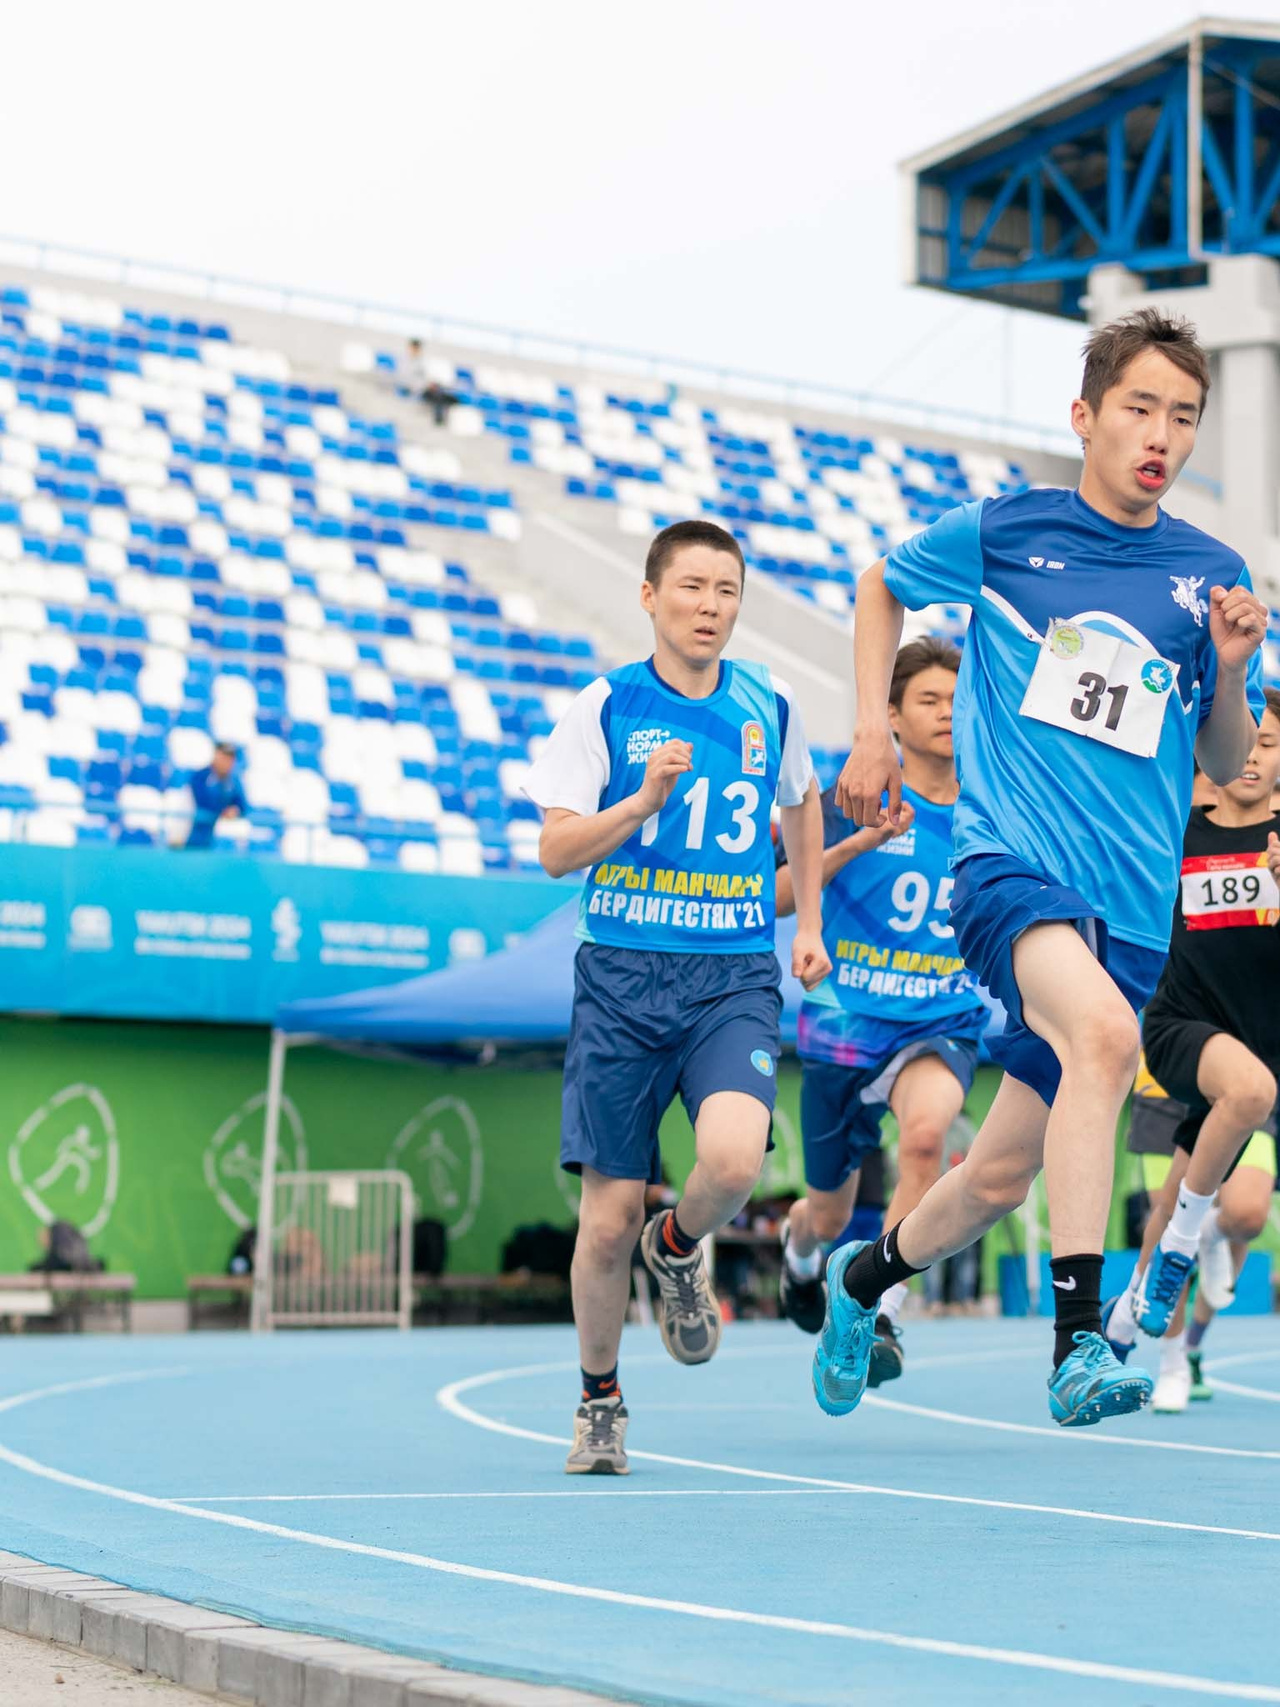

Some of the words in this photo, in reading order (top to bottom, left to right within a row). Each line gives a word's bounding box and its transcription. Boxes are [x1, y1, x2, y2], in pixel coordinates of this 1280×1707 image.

[1070, 671, 1130, 732] 31
[627, 739, 669, 753] НОРМ
[594, 863, 650, 891] ИГРЫ
[1201, 874, 1260, 906] 189
[588, 889, 766, 930] БЕРДИГЕСТЯК'21
[836, 939, 890, 968] ИГРЫ
